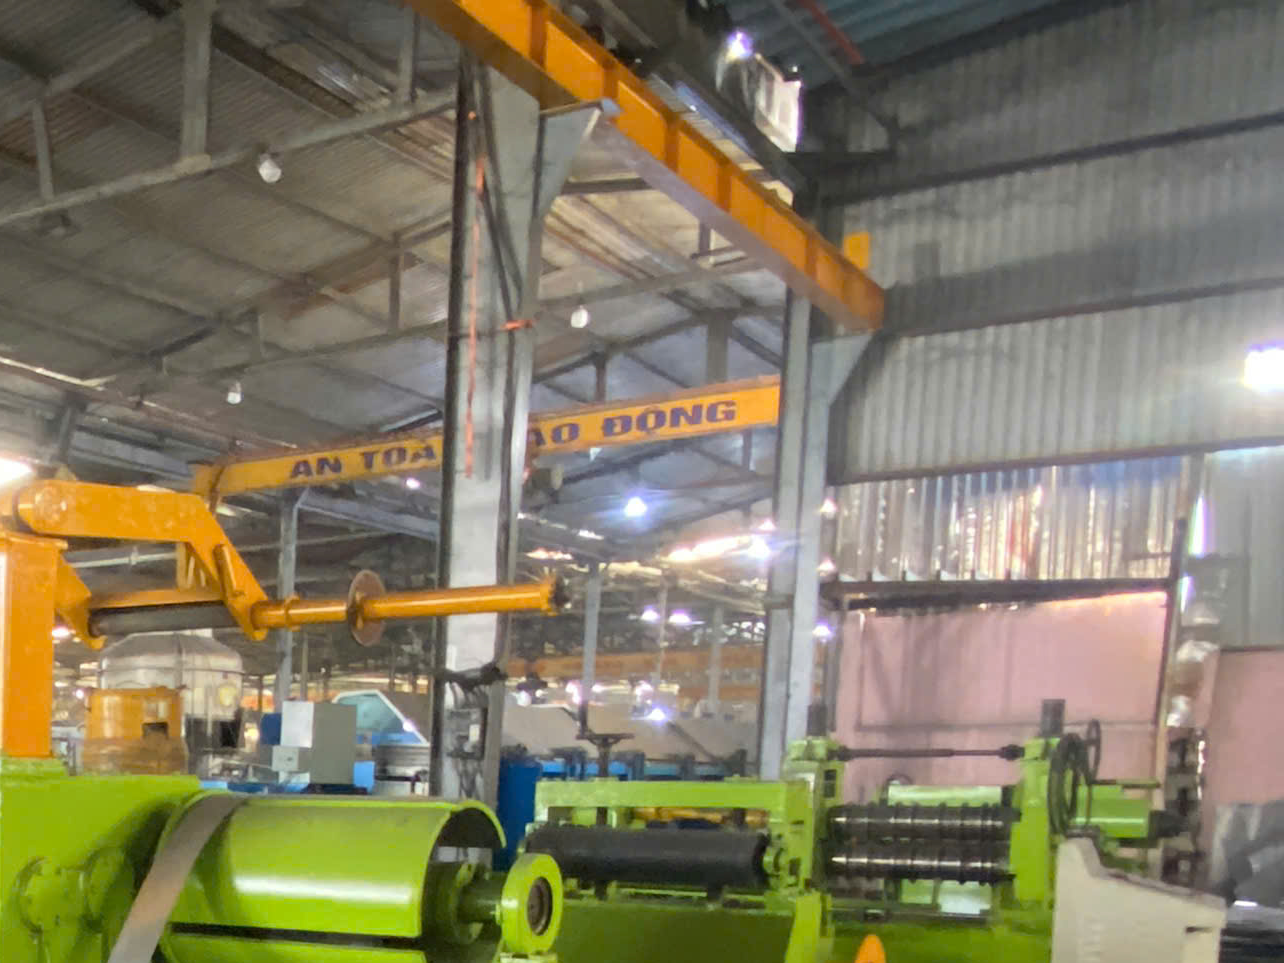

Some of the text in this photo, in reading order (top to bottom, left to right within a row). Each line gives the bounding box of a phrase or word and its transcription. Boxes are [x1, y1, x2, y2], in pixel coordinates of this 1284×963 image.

[290, 456, 343, 479] AN
[528, 422, 580, 448] AO
[601, 400, 737, 437] ĐỘNG
